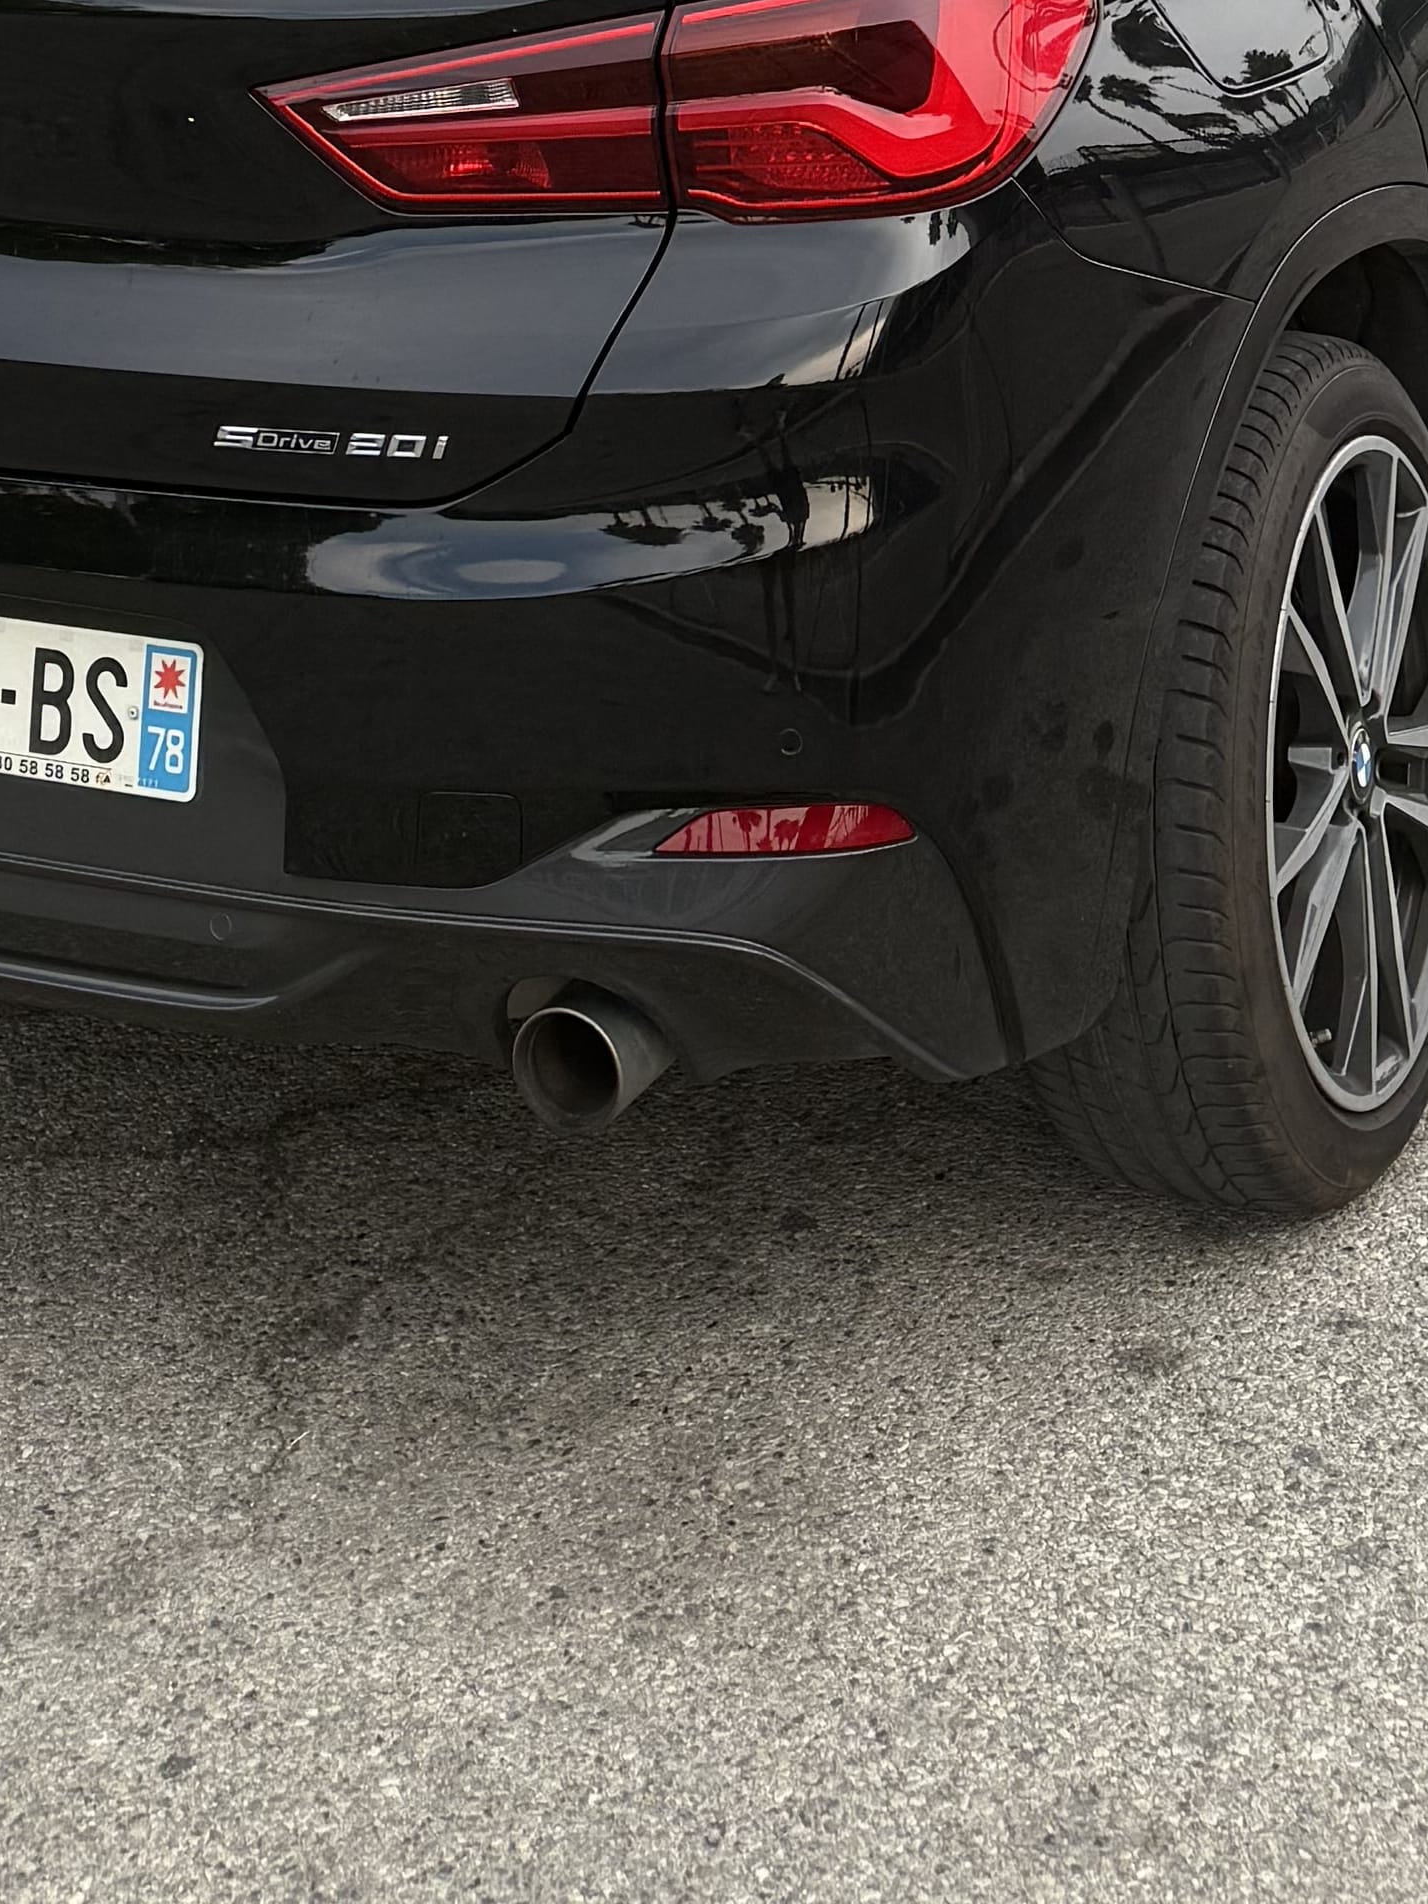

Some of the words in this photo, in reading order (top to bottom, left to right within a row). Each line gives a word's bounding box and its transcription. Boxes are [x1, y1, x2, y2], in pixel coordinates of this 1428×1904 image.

[147, 725, 185, 775] 78
[19, 759, 38, 775] 58
[45, 764, 64, 779] 58
[71, 768, 90, 783] 58
